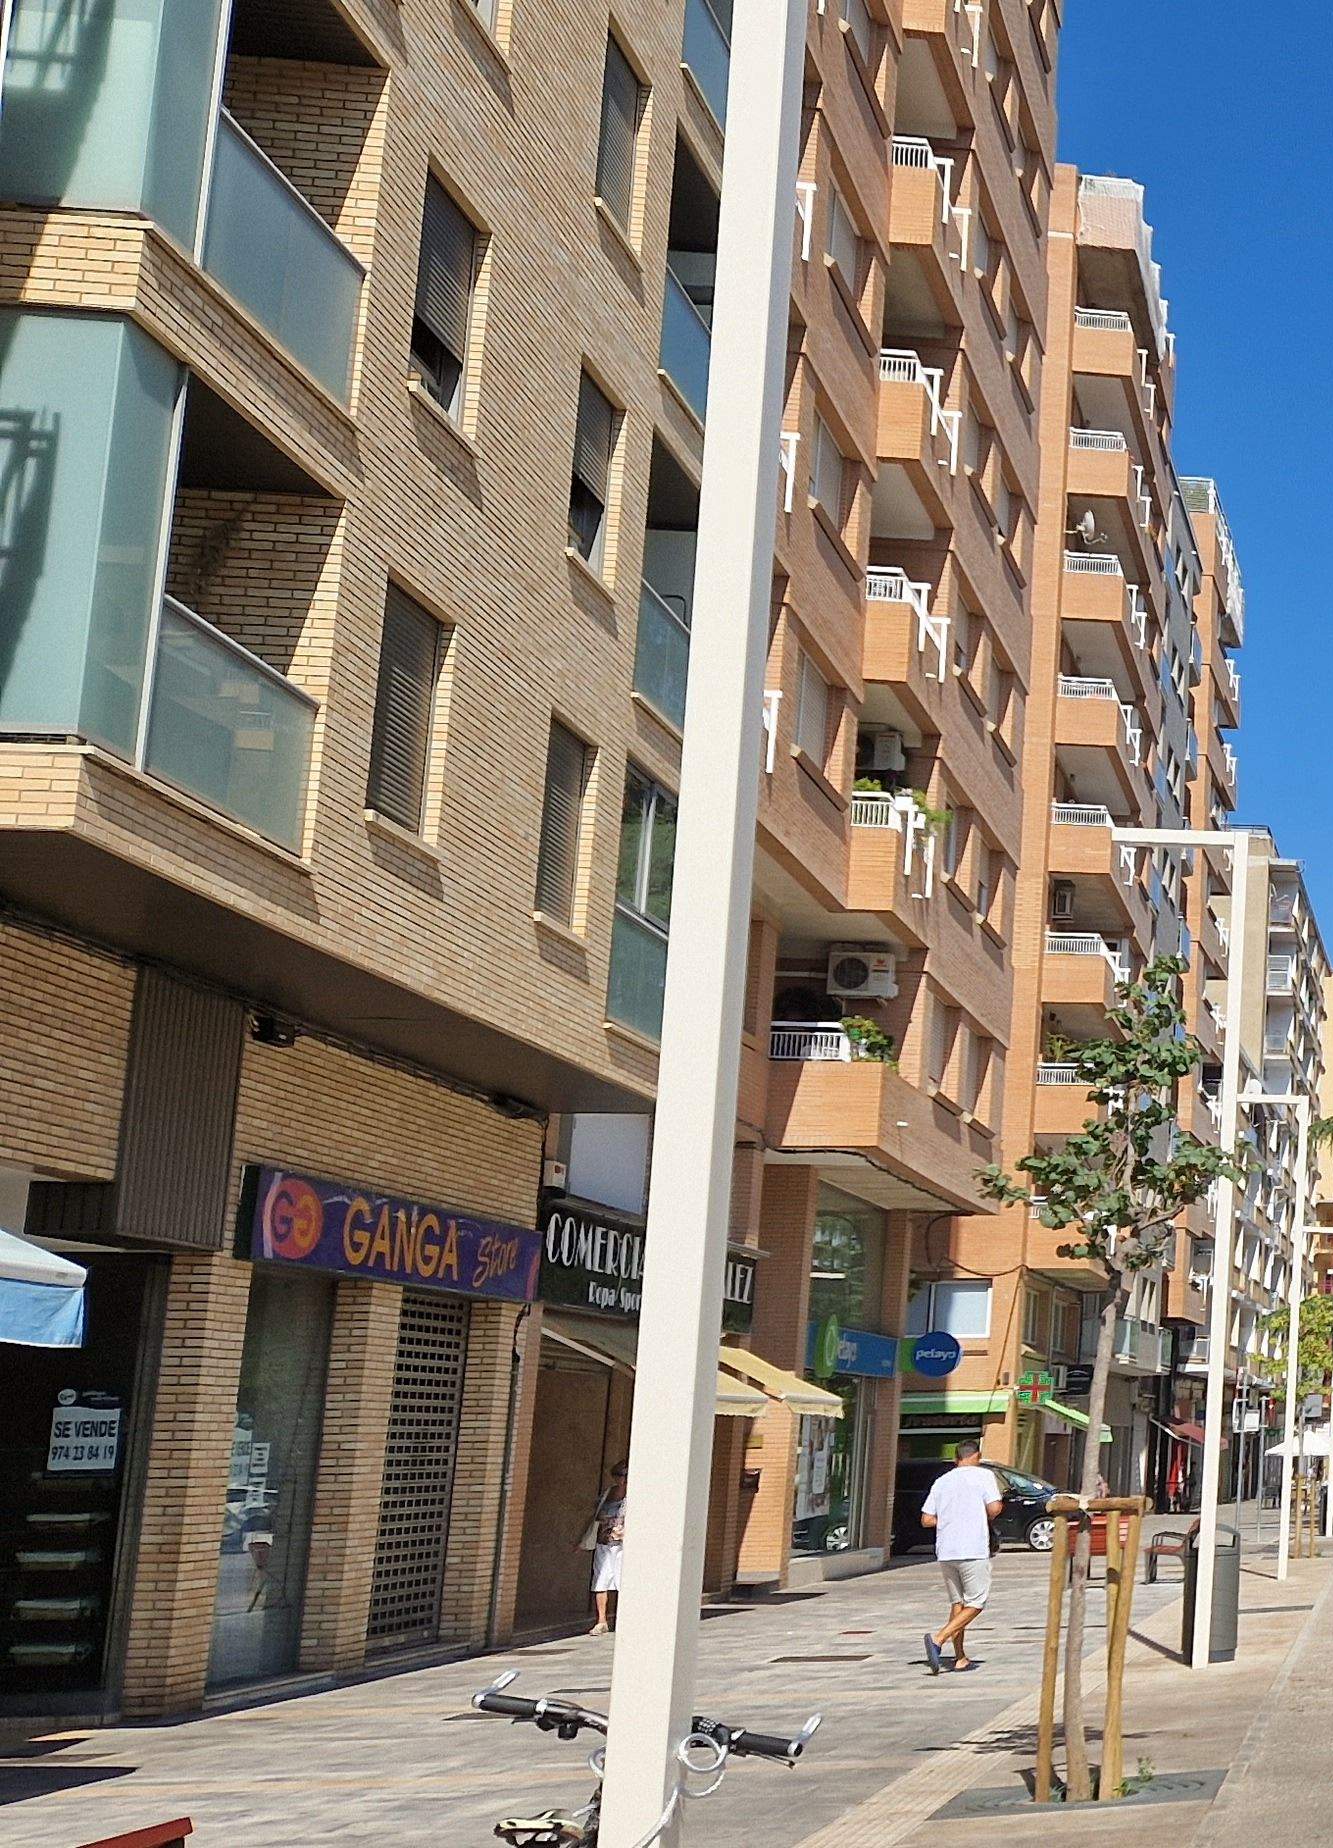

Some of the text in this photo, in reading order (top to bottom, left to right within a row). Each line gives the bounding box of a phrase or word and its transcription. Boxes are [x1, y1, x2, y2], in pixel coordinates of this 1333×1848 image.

[343, 1196, 519, 1288] GANGA Store
[546, 1212, 754, 1305] COMERCI LEZ
[619, 1287, 642, 1313] Spor
[915, 1347, 957, 1361] pelayo
[53, 1420, 117, 1439] SE VENDE
[102, 1444, 114, 1460] 19
